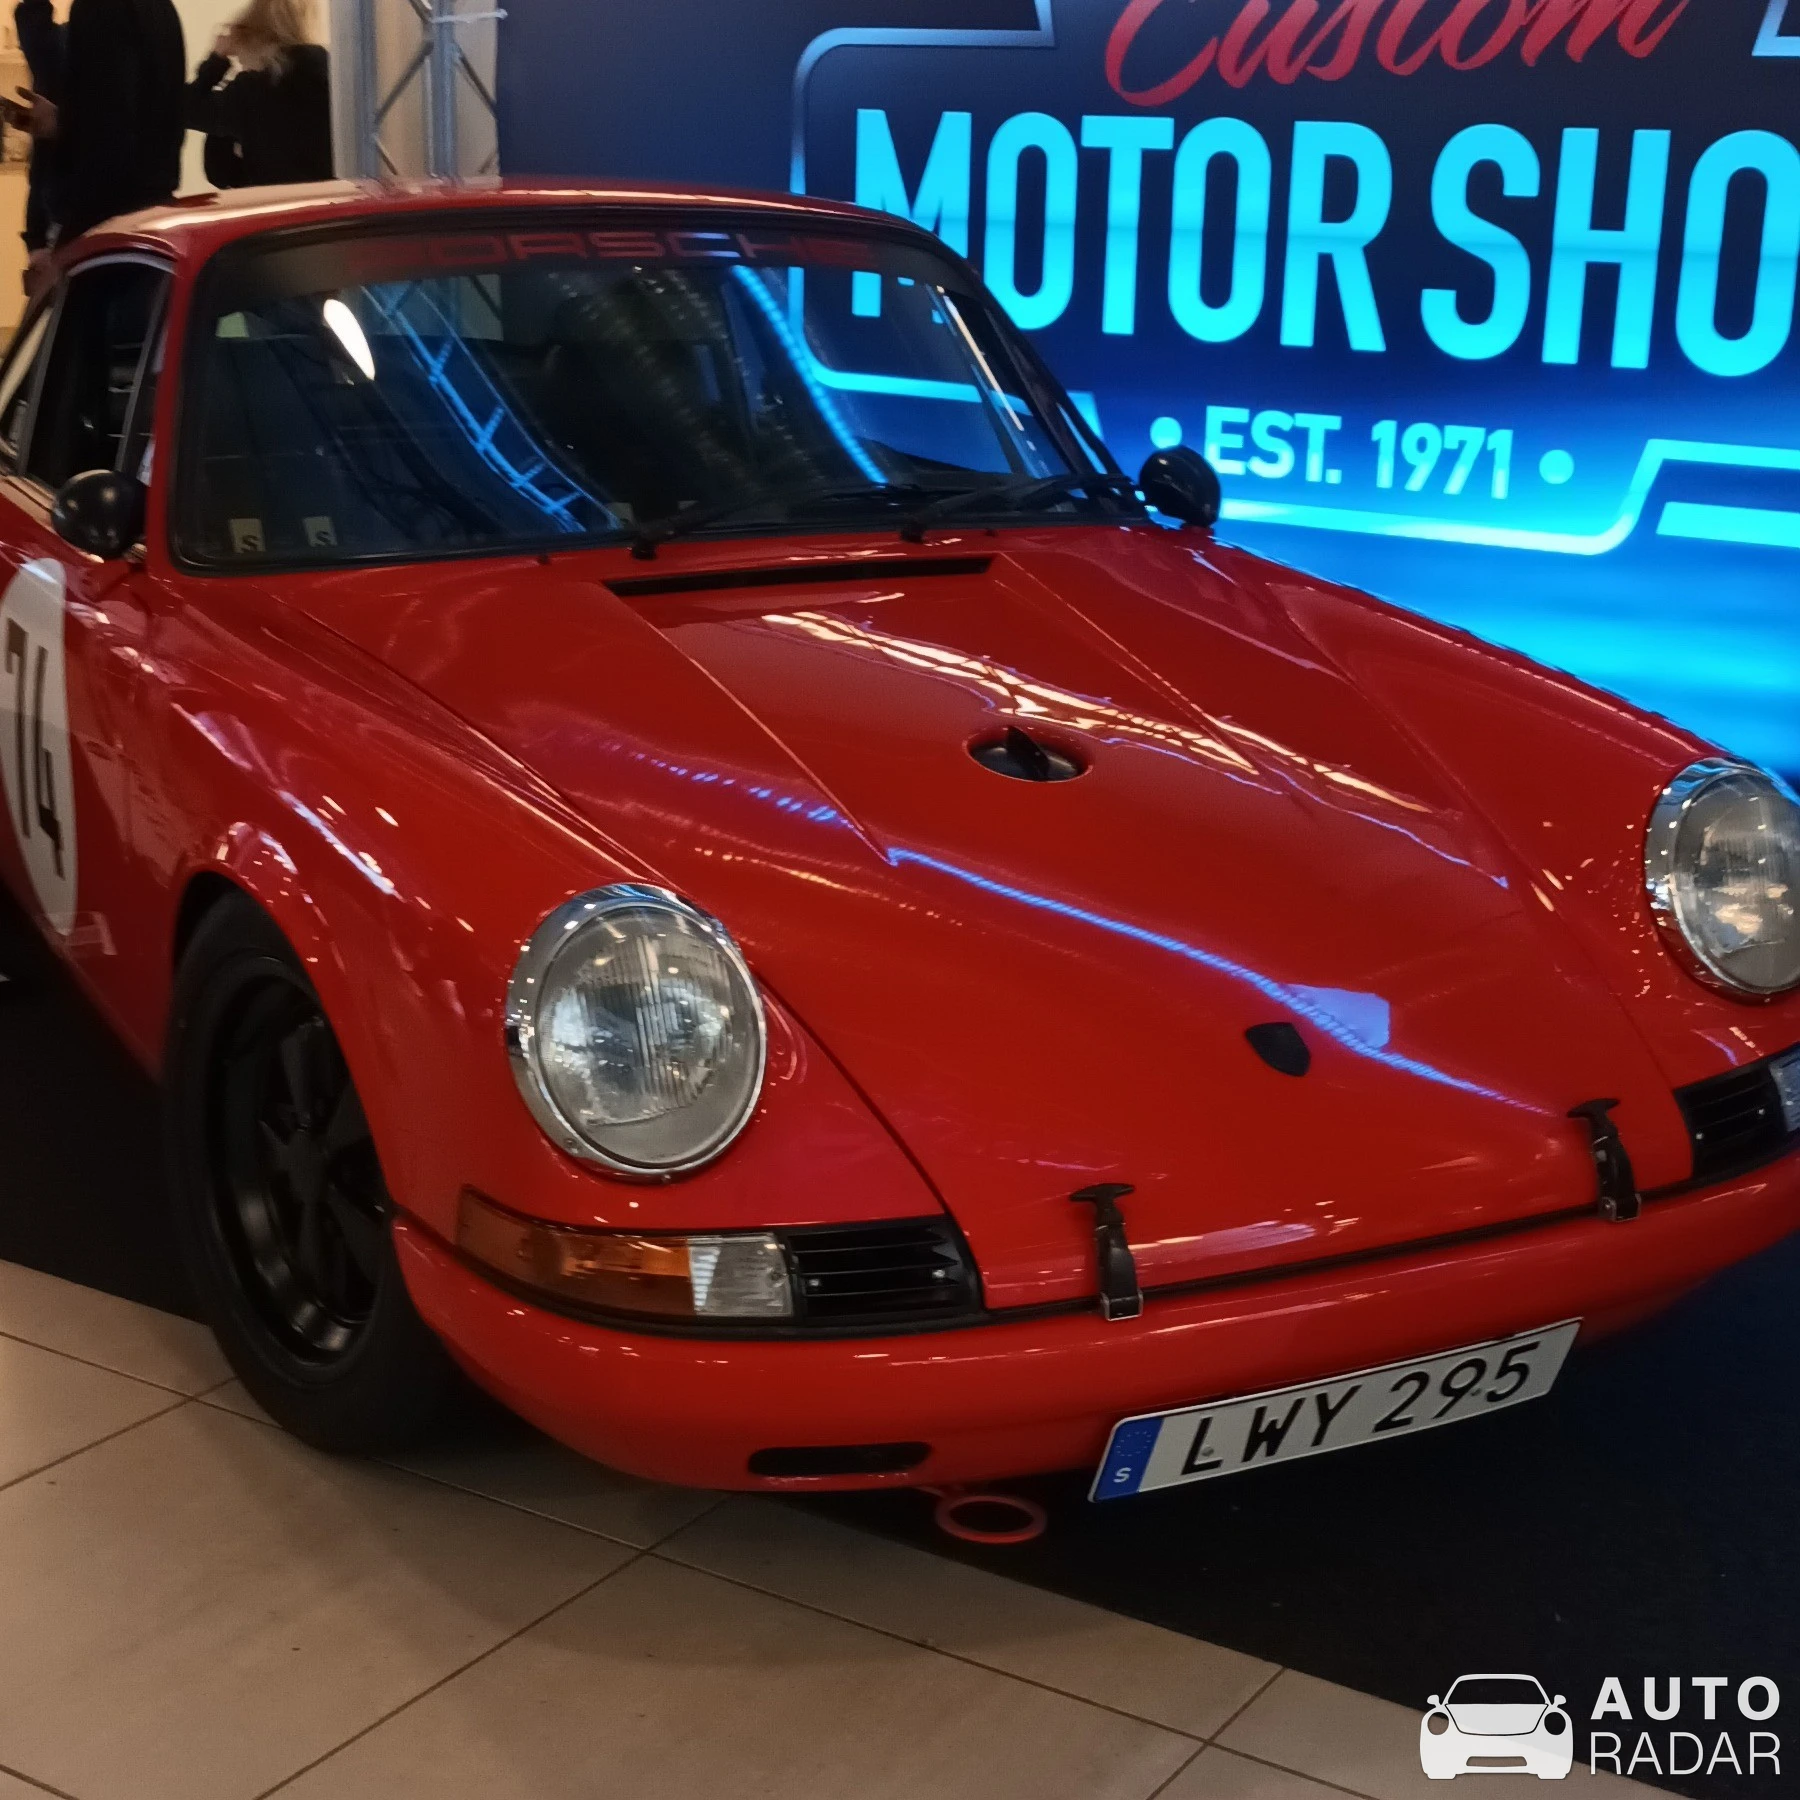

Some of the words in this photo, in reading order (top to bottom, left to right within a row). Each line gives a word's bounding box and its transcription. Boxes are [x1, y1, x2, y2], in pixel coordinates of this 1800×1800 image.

[852, 108, 1392, 352] MOTOR
[1204, 405, 1342, 484] EST.
[1371, 419, 1513, 499] 1971
[1181, 1385, 1362, 1475] LWY
[1372, 1340, 1541, 1433] 295
[1114, 1467, 1131, 1483] S
